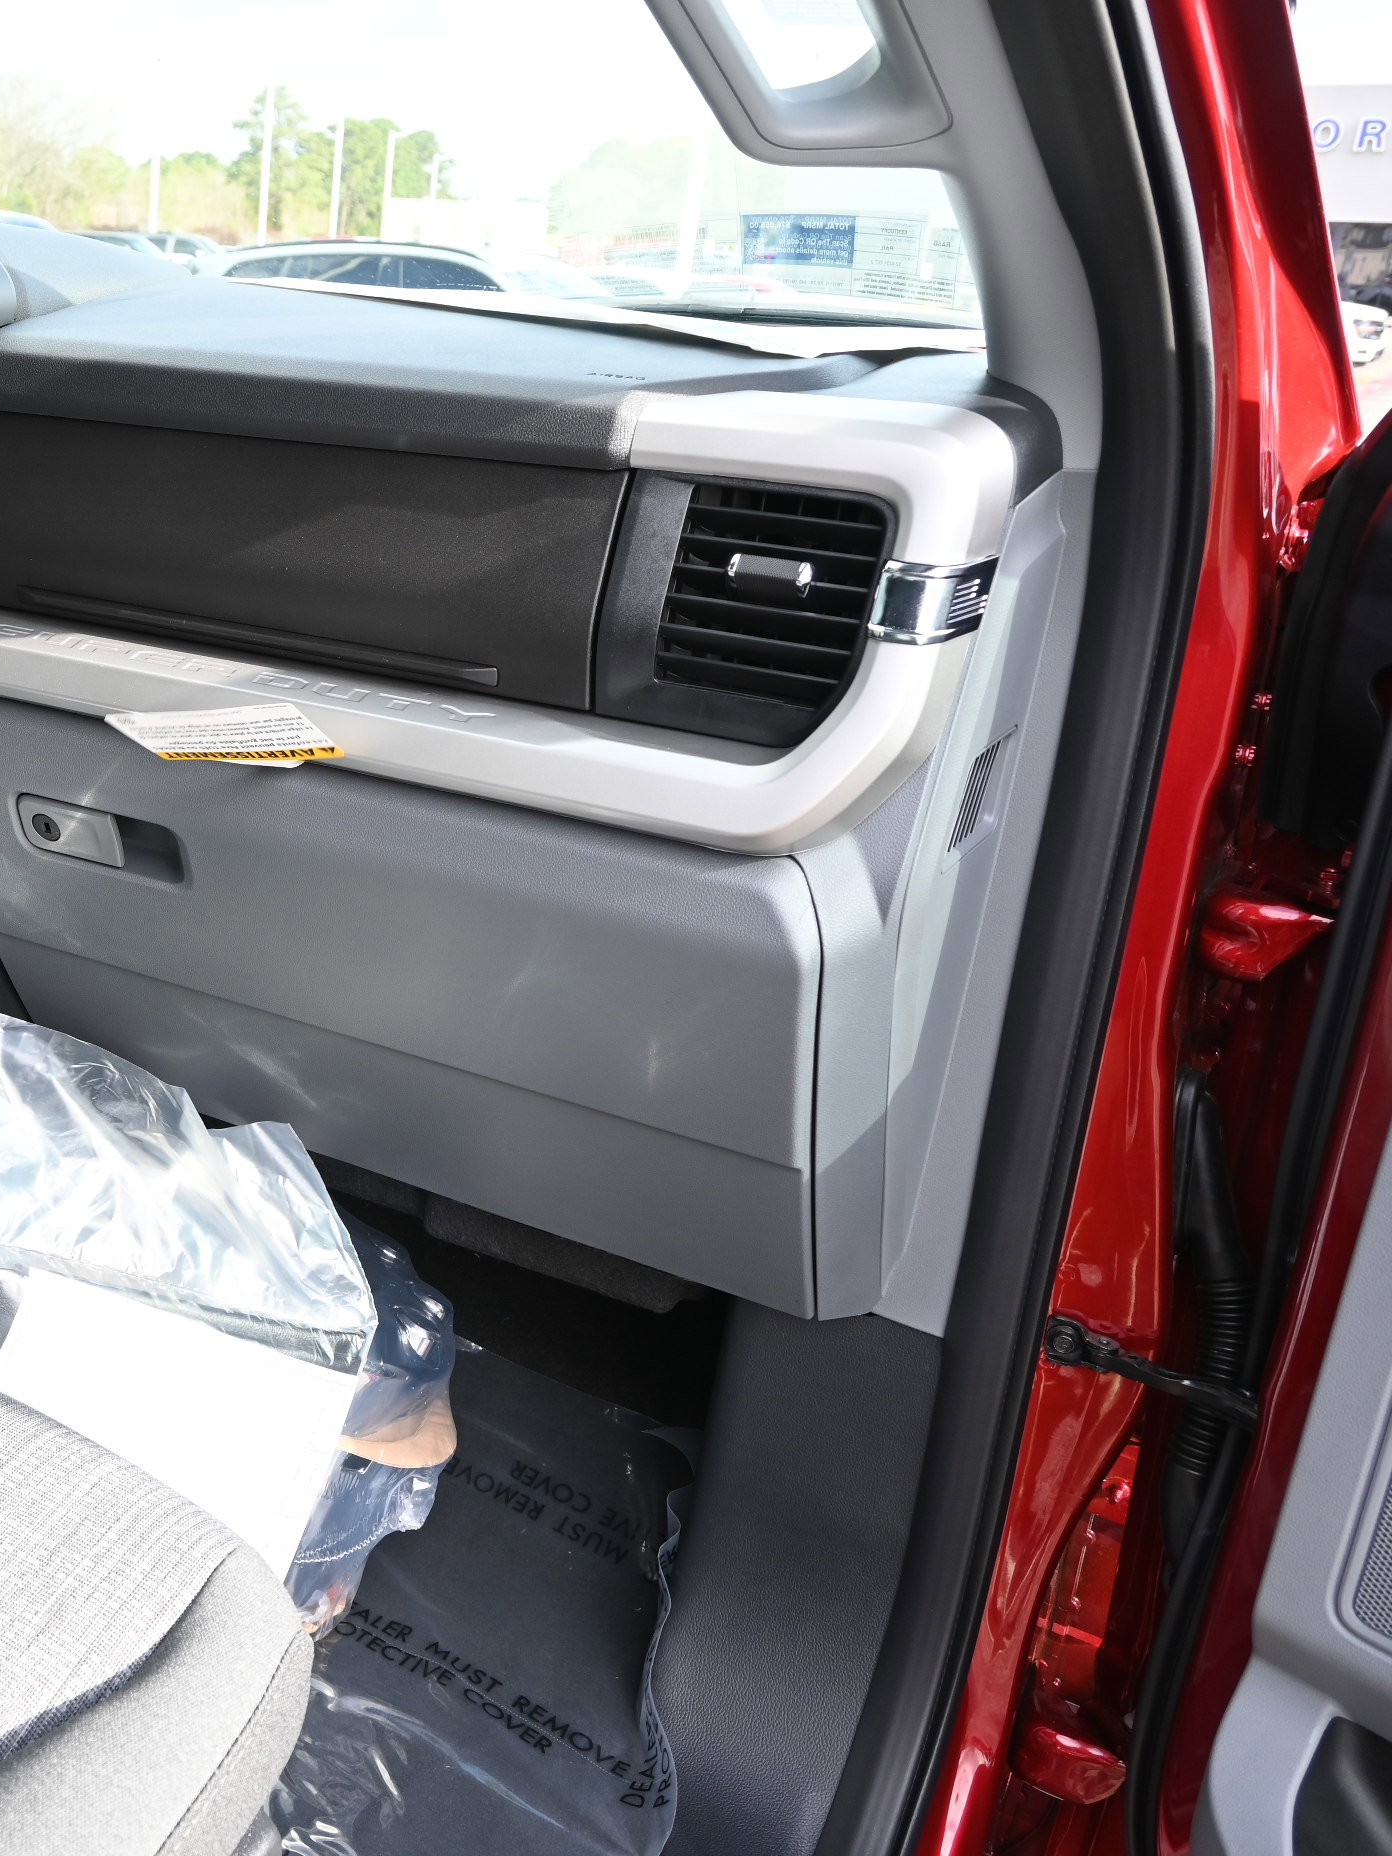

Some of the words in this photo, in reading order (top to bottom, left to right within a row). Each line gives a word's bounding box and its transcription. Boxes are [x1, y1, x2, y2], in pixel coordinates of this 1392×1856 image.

[253, 672, 496, 722] DUTY
[165, 748, 315, 758] AVERTISSEMENT
[510, 1460, 591, 1513] COVER
[553, 1516, 630, 1564] MUST
[349, 1602, 412, 1642] ALER
[426, 1642, 503, 1693] MUST
[512, 1694, 631, 1778] REMOVE
[464, 1688, 553, 1755] COVER
